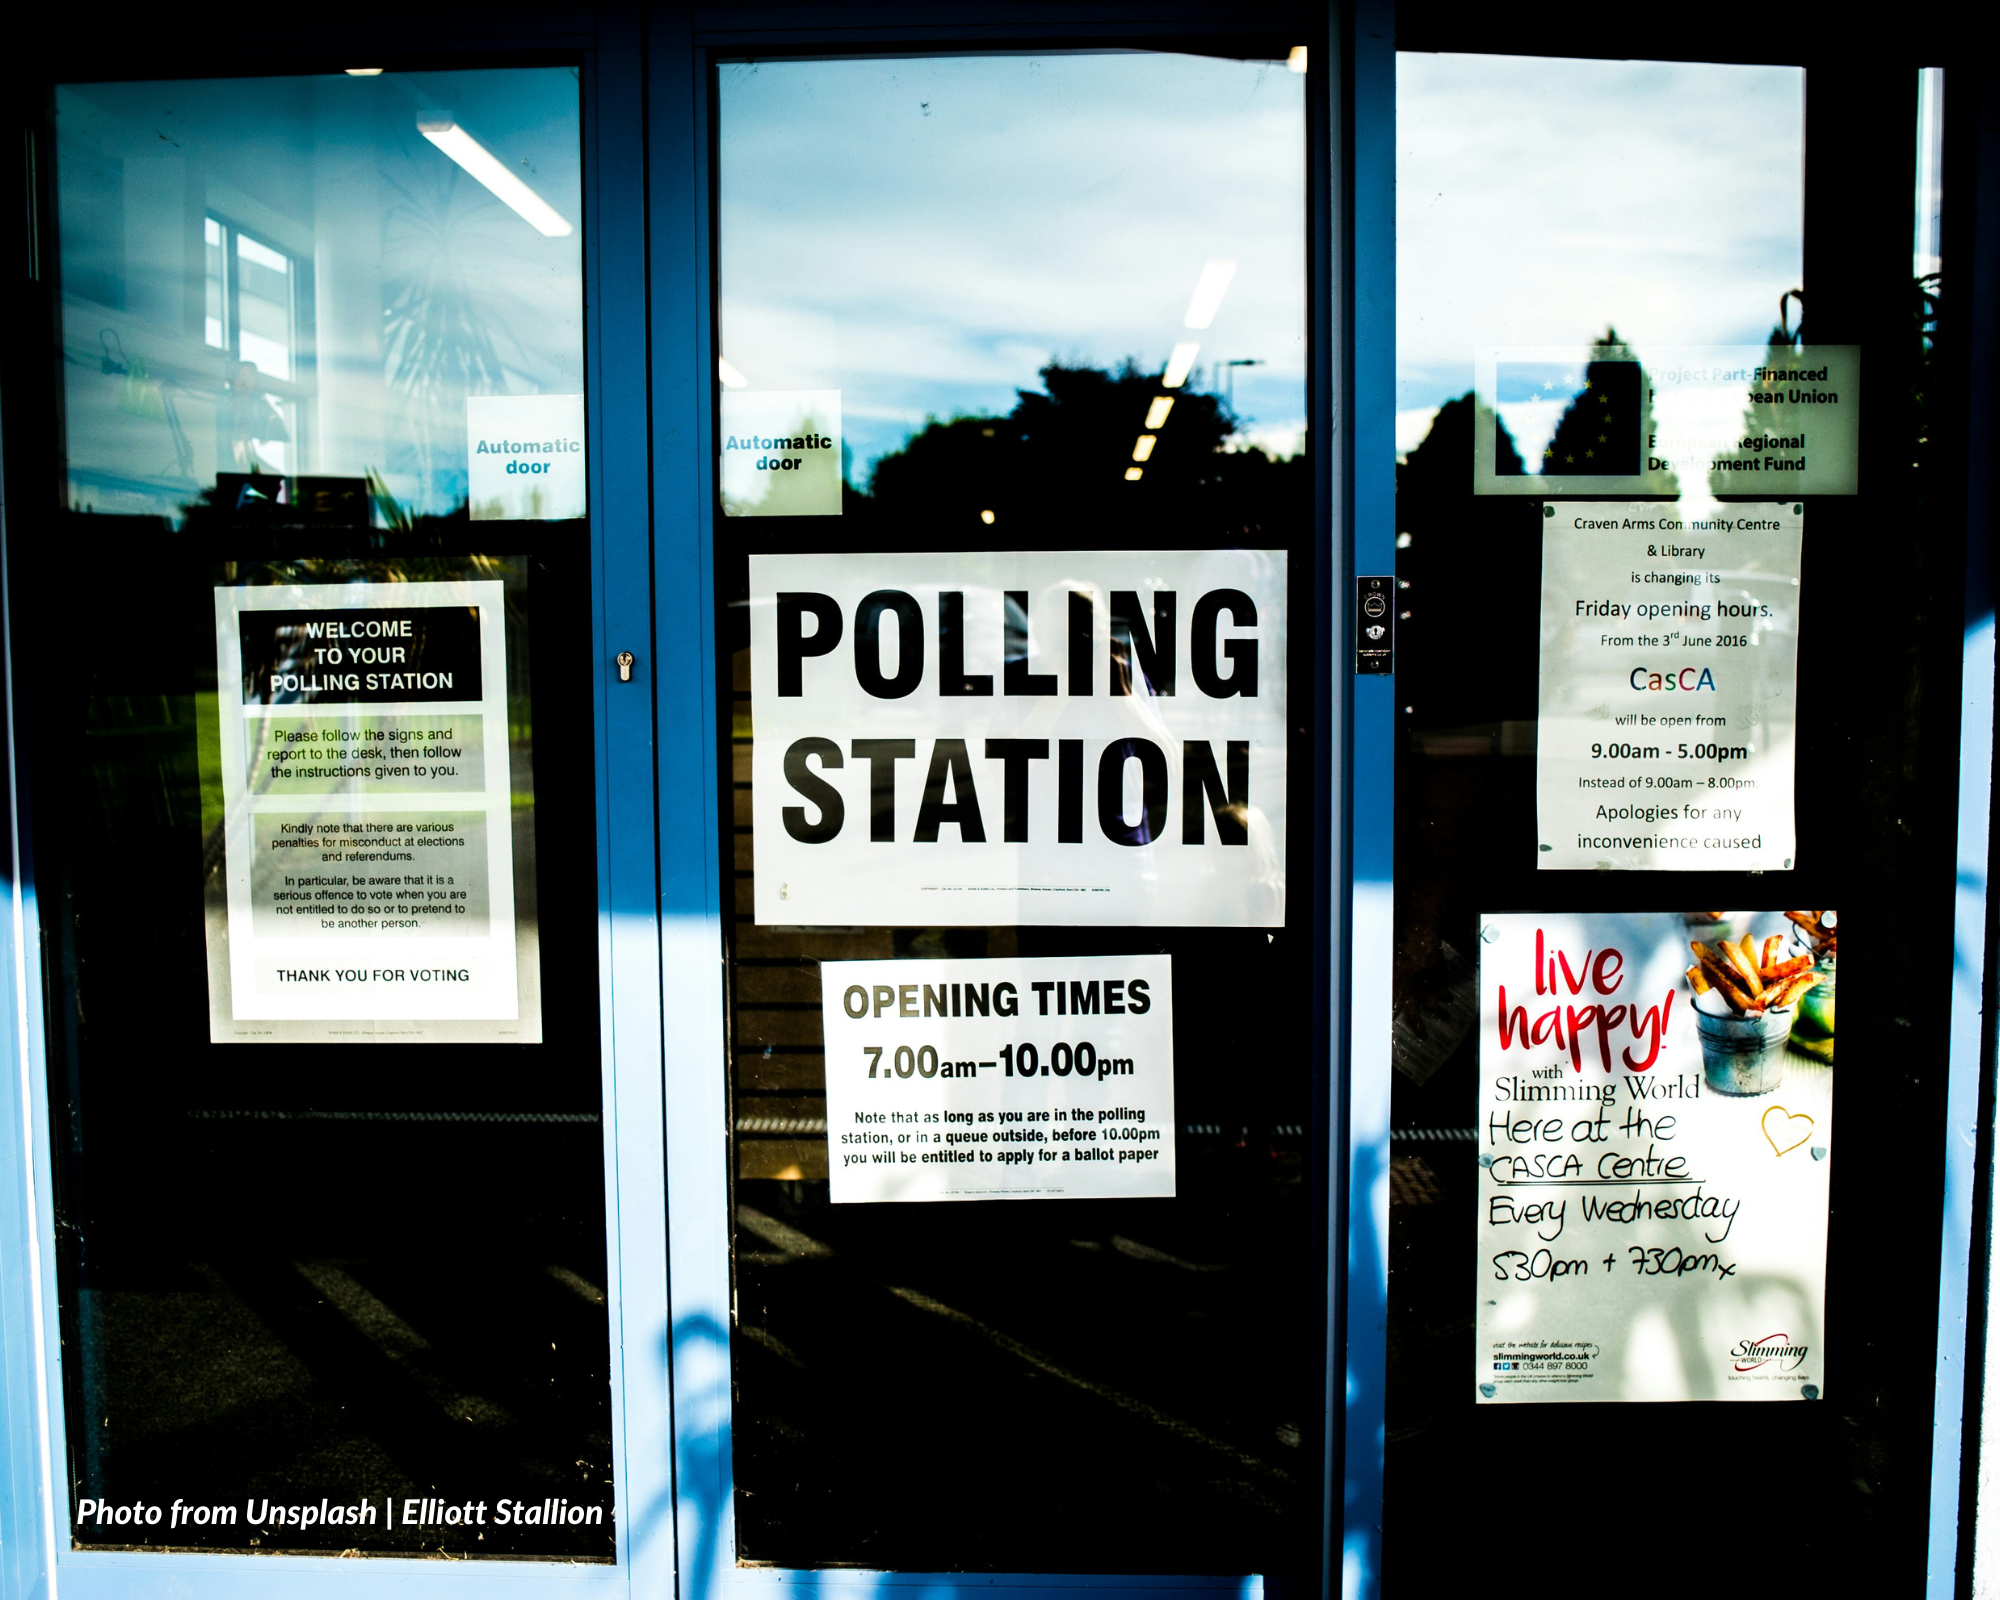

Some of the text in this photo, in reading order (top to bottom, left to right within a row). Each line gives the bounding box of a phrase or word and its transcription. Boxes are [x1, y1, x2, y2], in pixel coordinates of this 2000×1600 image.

[1712, 366, 1827, 382] Part-Financed
[1789, 389, 1838, 404] Union
[476, 439, 579, 454] Automatic
[727, 433, 832, 451] Automatic
[506, 460, 550, 474] door
[757, 455, 802, 470] door
[1575, 518, 1618, 529] Craven
[1622, 519, 1655, 529] Arms
[1737, 519, 1780, 530] Centre
[1647, 545, 1705, 559] & Library
[1632, 571, 1721, 586] is changing its
[1576, 600, 1772, 620] Friday opening hours.
[304, 621, 412, 638] WELCOME
[776, 588, 1259, 699] POLLING
[1602, 635, 1633, 646] From
[1638, 635, 1658, 646] the
[1683, 636, 1711, 646] June
[1716, 635, 1747, 646] 2016
[314, 647, 405, 664] TO YOUR
[270, 672, 453, 692] POLLING STATION
[1630, 667, 1716, 692] CasCA
[1615, 714, 1726, 727] will be open from
[275, 728, 452, 743] Please follow the signs and
[268, 746, 461, 763] report to the desk, then follow
[1592, 743, 1659, 758] 9.00am
[1678, 744, 1747, 763] 5.00pm
[271, 765, 458, 779] the instructions given to you.
[782, 736, 1250, 846] STATION
[1579, 777, 1624, 788] Instead
[1629, 777, 1642, 788] of
[1646, 777, 1692, 788] 9.00am
[1596, 804, 1741, 822] Apologies for any
[281, 822, 454, 835] Kindly note that there are various
[1578, 834, 1761, 849] inconvenience caused
[322, 851, 415, 861] and referendums.
[1535, 928, 1623, 996] live
[277, 969, 469, 981] THANK YOU FOR VOTING
[844, 979, 1150, 1018] OPENING TIMES
[1498, 985, 1675, 1073] happy!
[1532, 1065, 1563, 1079] with
[1494, 1073, 1700, 1106] Slimming World
[855, 1107, 1145, 1126] Note that as long as you are in the polling
[1489, 1106, 1676, 1146] Here at the
[842, 1128, 1160, 1146] station, or in a queue outside, before 10.00pm
[844, 1148, 1158, 1167] you will be entitled to apply for a ballot paper
[1489, 1144, 1690, 1183] CASCA Centre
[1489, 1186, 1741, 1243] Every Wednesday
[1602, 1253, 1616, 1272] +
[1493, 1352, 1589, 1361] slimmingworld.co.uk
[1731, 1340, 1808, 1365] Slimming
[1523, 1362, 1587, 1370] 0344 897 8000
